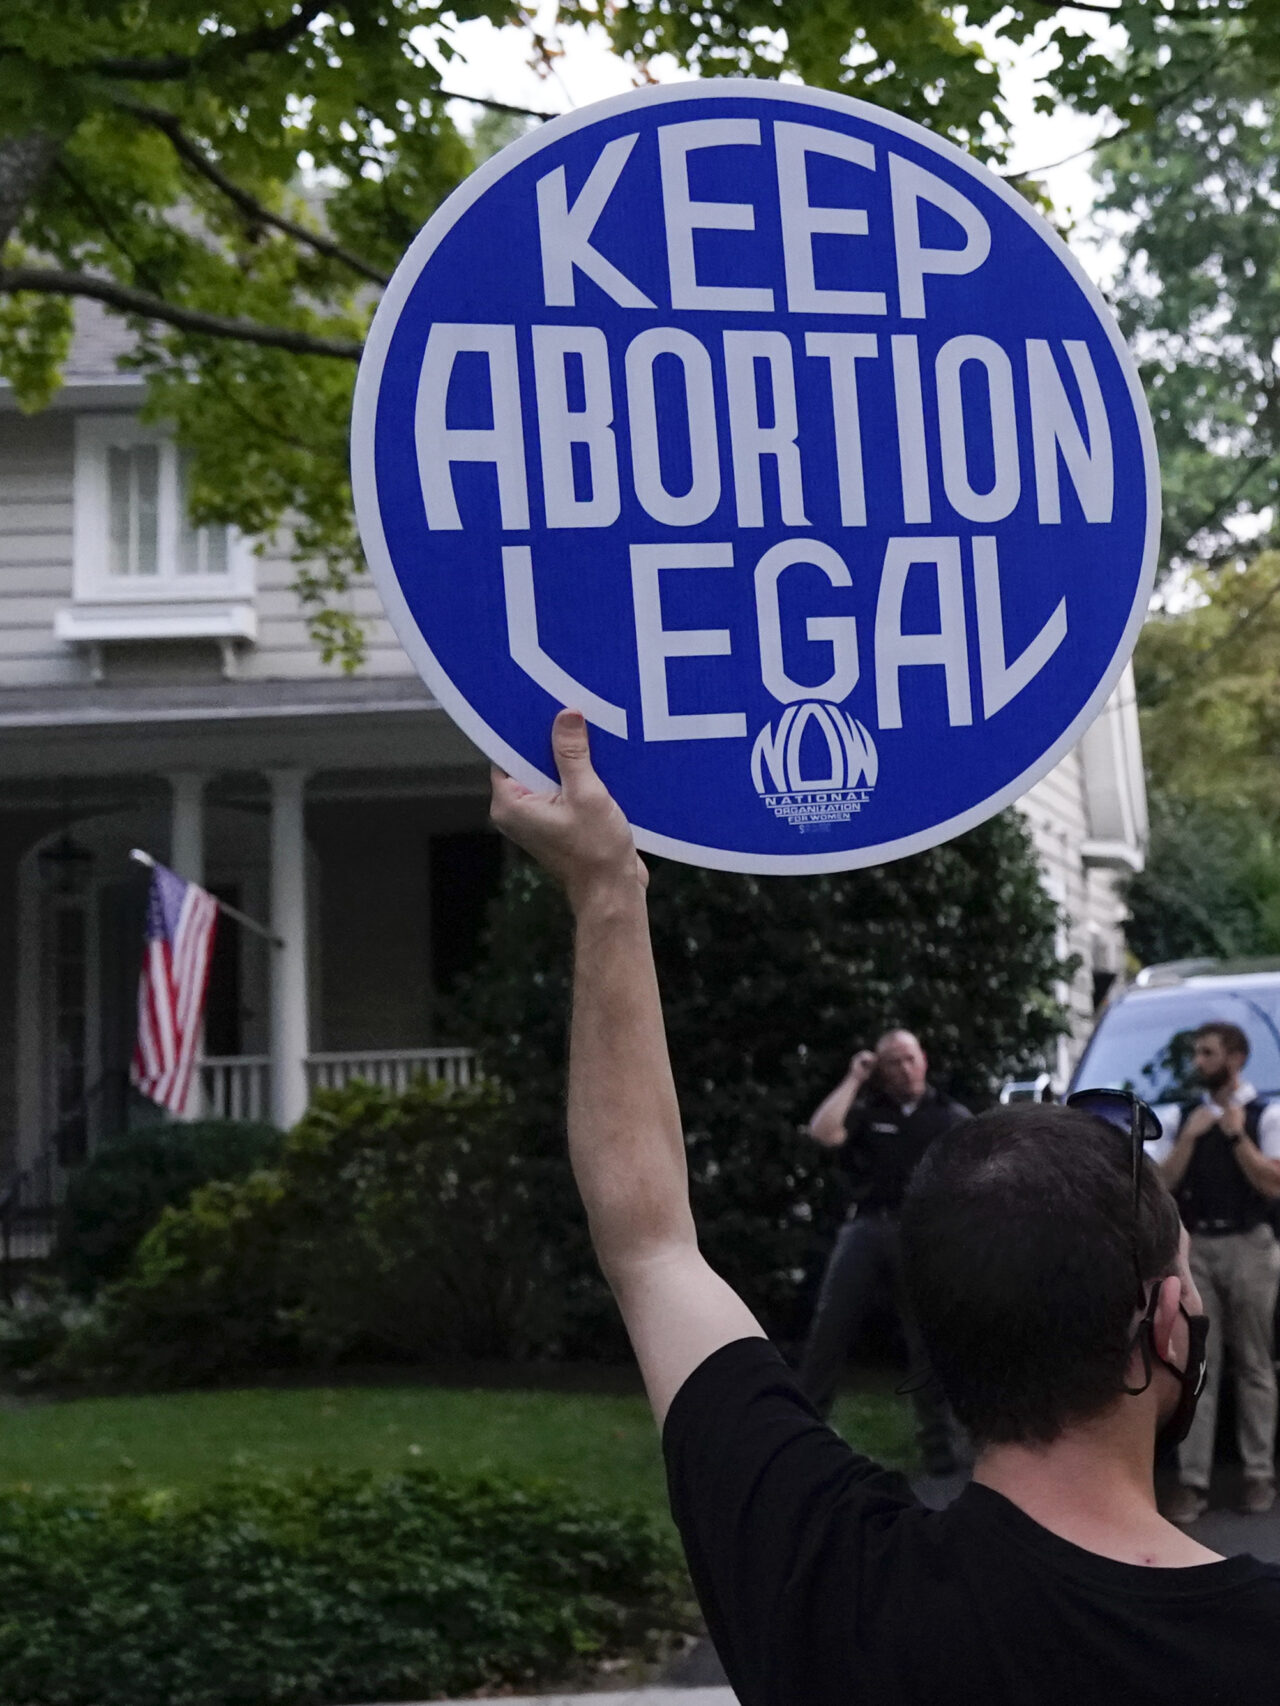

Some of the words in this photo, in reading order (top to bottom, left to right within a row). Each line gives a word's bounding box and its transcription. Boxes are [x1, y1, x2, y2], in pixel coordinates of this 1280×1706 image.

[537, 118, 992, 319] KEEP
[414, 323, 1115, 531] ABORTION
[501, 536, 1068, 742] LEGAL
[750, 702, 879, 794] NOW
[765, 791, 870, 806] NATIONAL
[774, 803, 861, 815] ORGANIZATION
[788, 815, 808, 823] FOR
[810, 813, 850, 822] WOMEN
